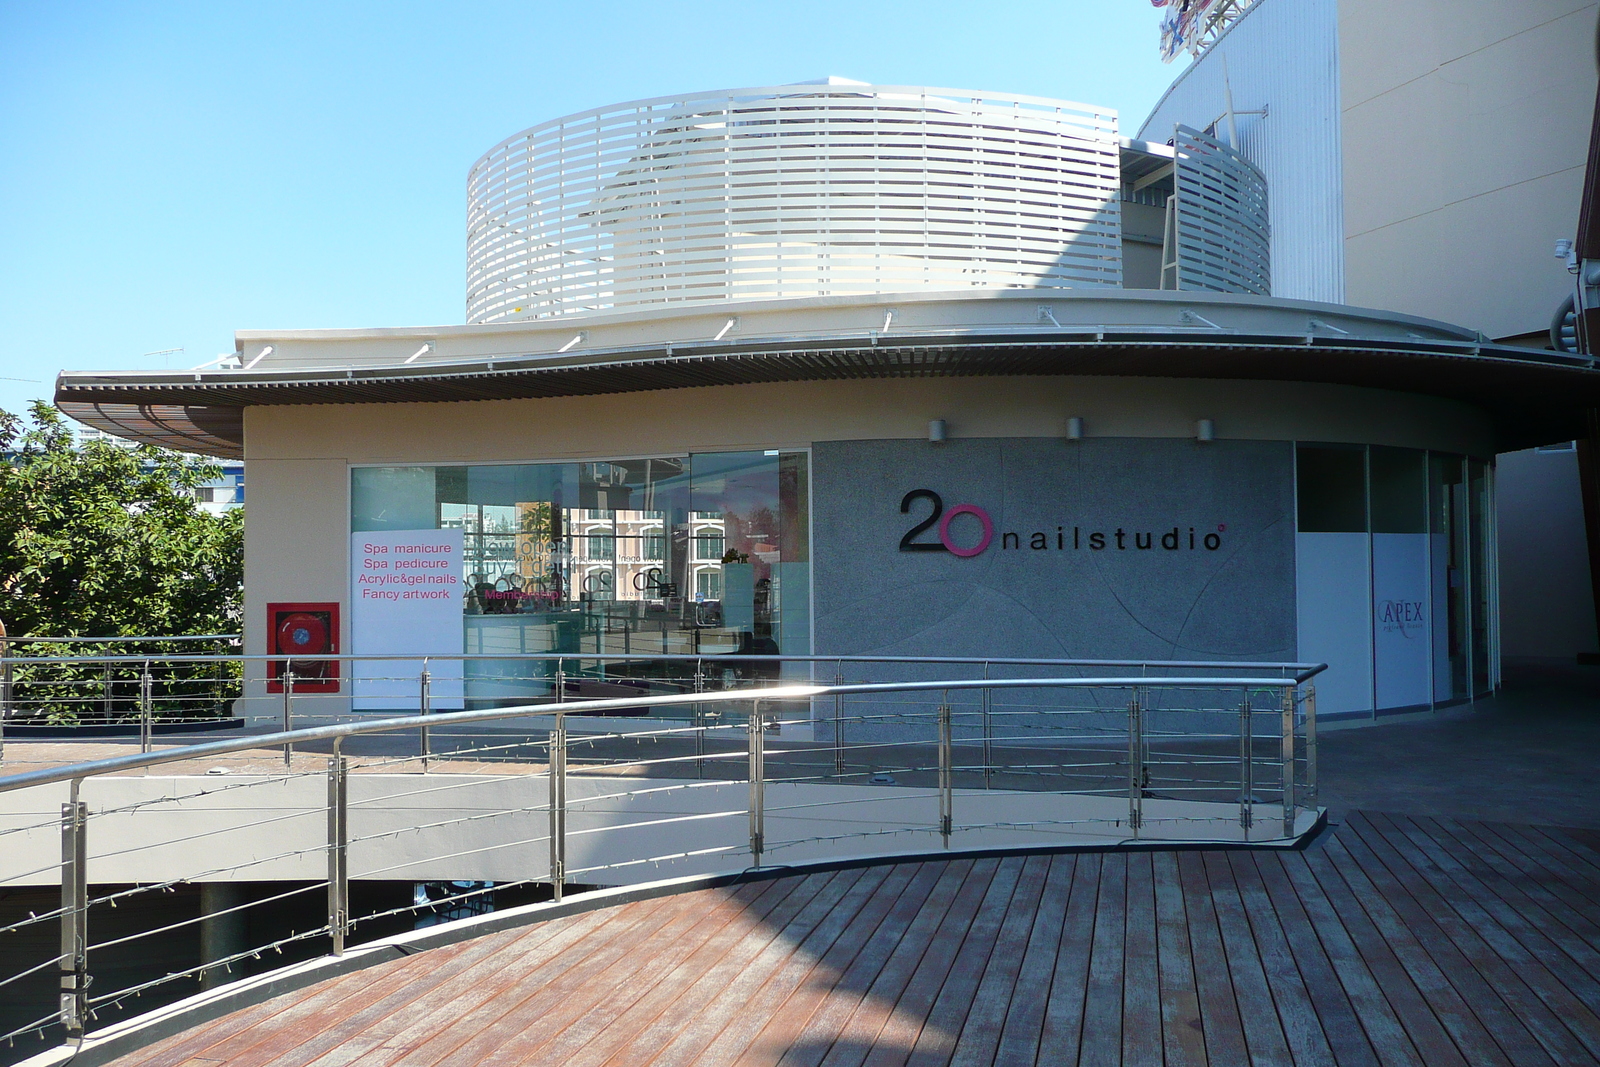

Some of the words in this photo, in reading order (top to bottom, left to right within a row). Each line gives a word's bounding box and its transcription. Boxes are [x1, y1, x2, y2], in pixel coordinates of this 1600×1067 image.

[899, 488, 993, 558] 20
[1002, 526, 1221, 551] nailstudio
[364, 543, 389, 555] Spa
[394, 543, 452, 554] manicure
[364, 558, 389, 570] Spa
[394, 558, 449, 571] pedicure
[358, 573, 426, 586] Acrylic&gel
[428, 573, 457, 584] nails
[362, 588, 400, 601] Fancy
[1383, 602, 1423, 622] APEX
